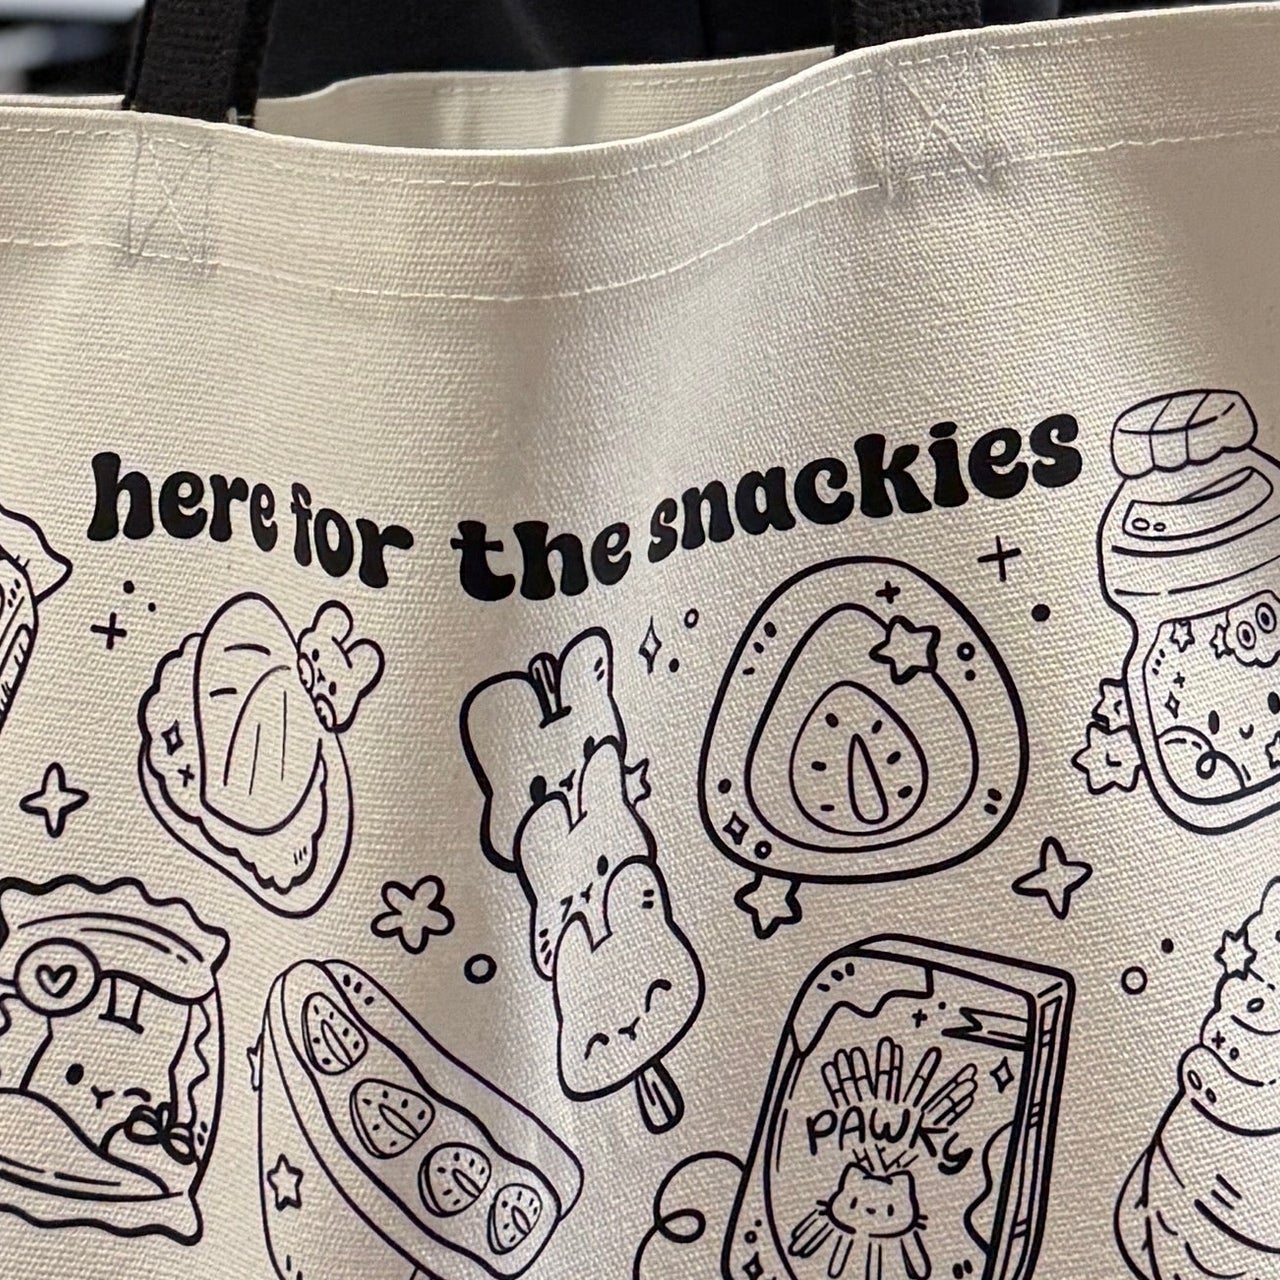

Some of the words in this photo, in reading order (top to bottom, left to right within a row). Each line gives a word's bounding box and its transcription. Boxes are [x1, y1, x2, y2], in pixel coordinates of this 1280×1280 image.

[86, 451, 278, 552] here
[290, 482, 414, 589] for
[449, 519, 632, 602] the
[647, 413, 1083, 564] snackies
